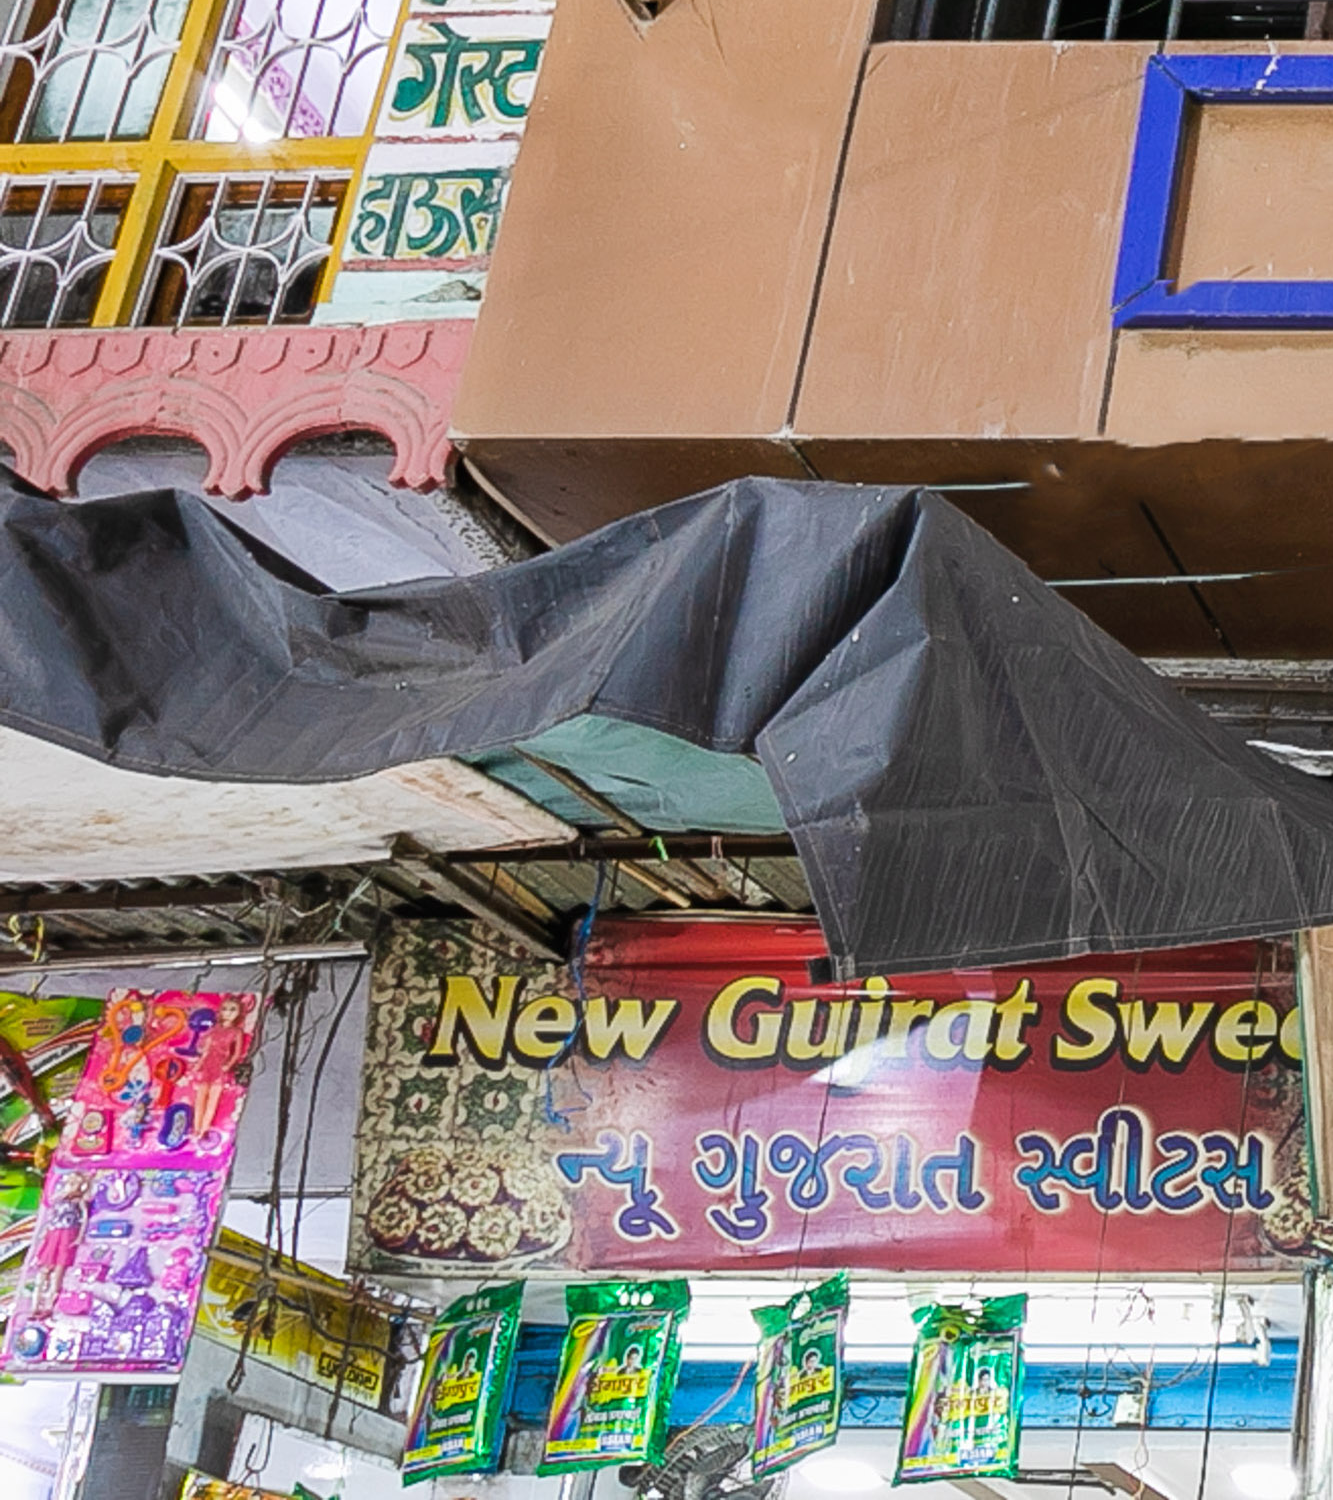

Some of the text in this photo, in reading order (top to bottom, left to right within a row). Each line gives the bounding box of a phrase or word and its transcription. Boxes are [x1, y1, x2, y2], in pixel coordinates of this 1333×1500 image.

[391, 21, 546, 128] गेस्ट
[426, 975, 679, 1062] New
[706, 975, 1038, 1090] Gujrat
[557, 1105, 1276, 1241] ન્યૂ ગુજરાત સ્વીટસ
